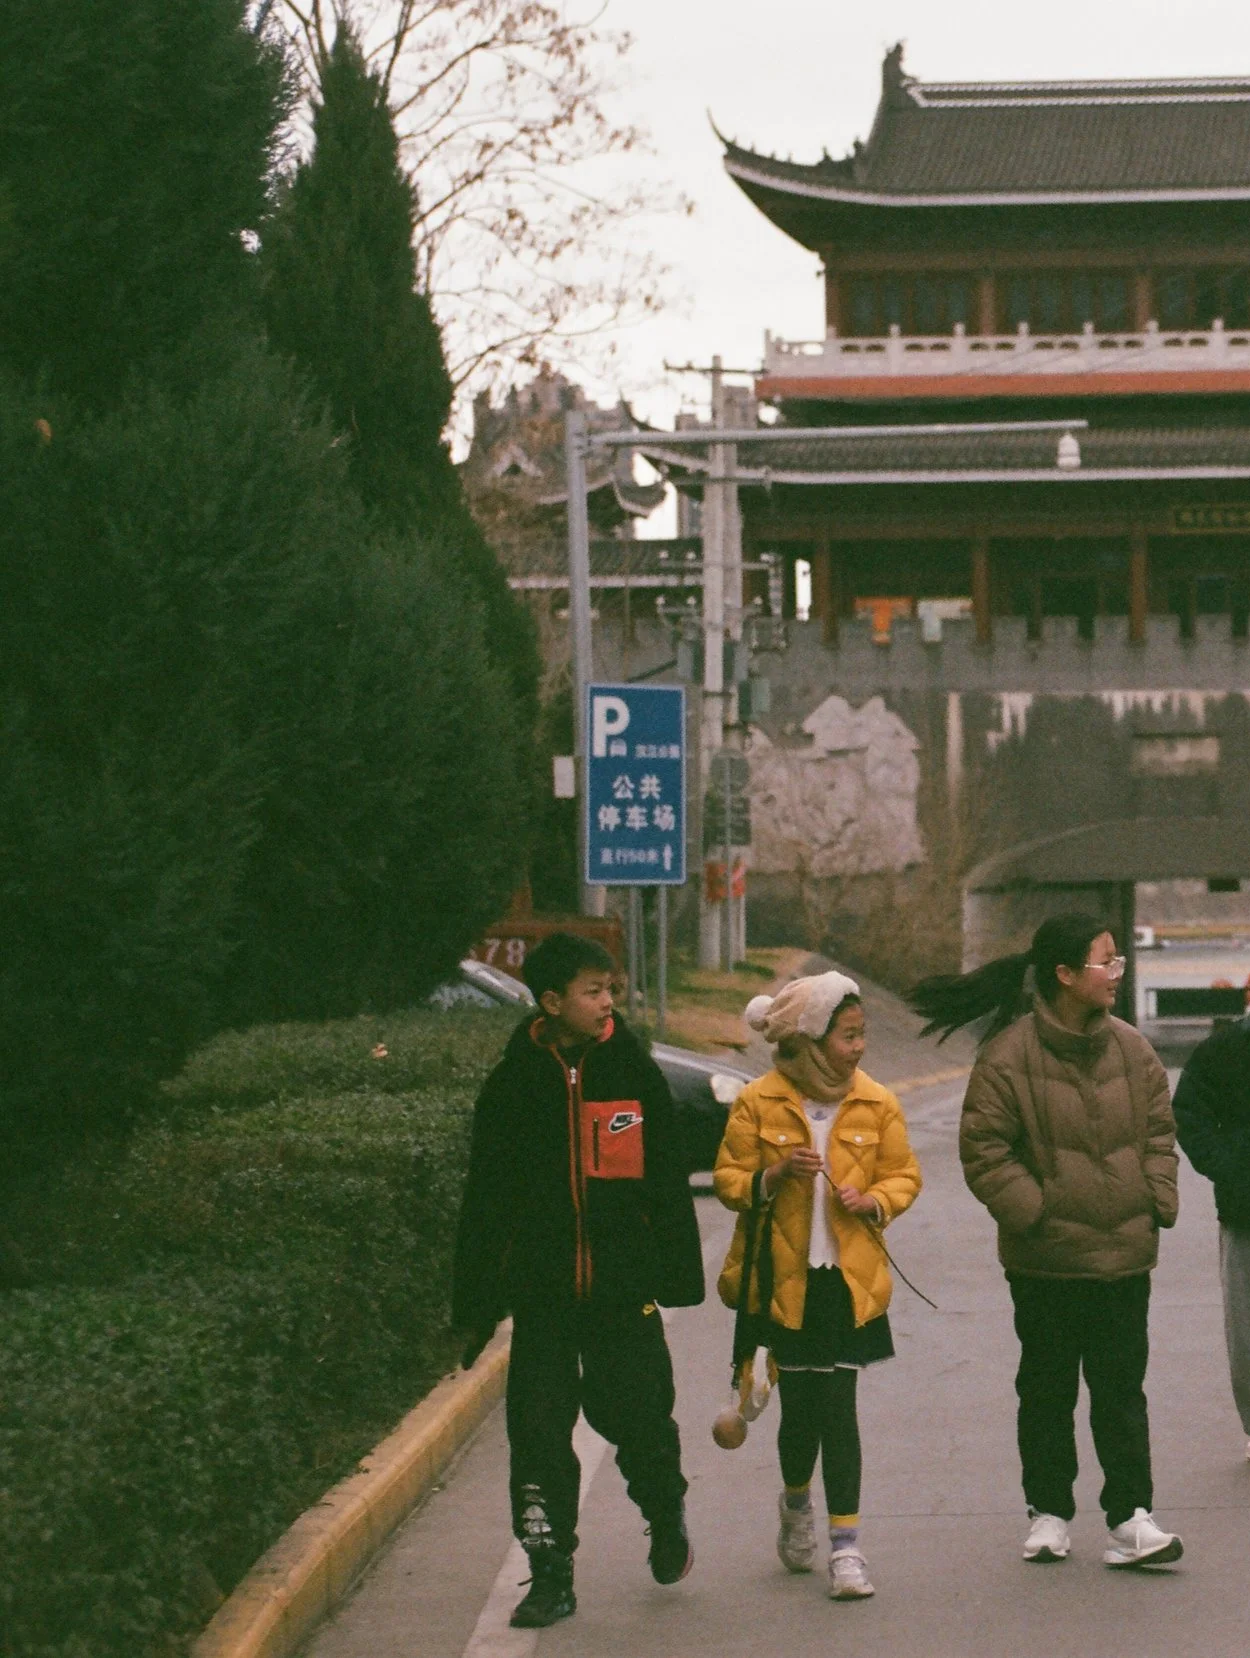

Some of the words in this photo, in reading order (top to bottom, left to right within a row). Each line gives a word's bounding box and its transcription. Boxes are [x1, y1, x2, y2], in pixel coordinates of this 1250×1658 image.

[593, 696, 631, 757] P
[612, 774, 662, 799] 公共
[597, 804, 675, 831] 停车场
